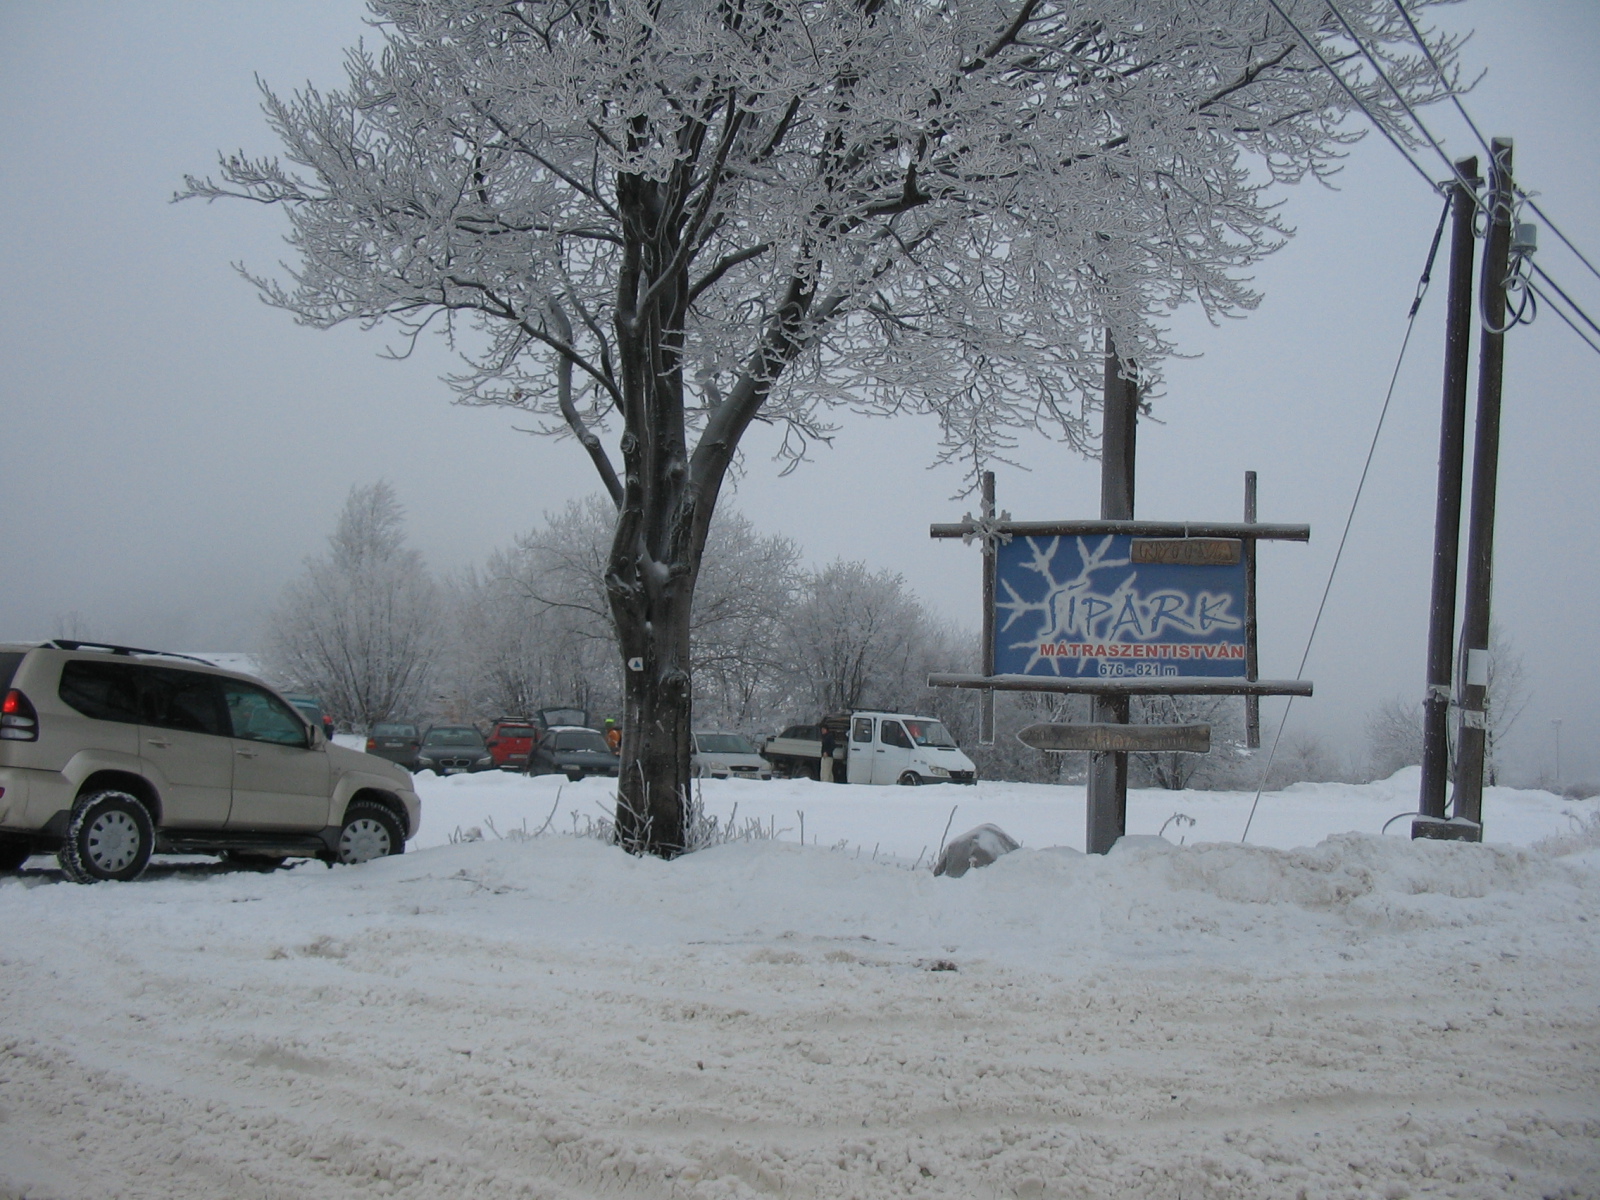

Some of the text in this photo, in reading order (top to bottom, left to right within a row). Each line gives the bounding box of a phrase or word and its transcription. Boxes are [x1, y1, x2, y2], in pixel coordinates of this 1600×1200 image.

[1042, 582, 1237, 641] SÍPARK
[1040, 641, 1244, 658] MÁTRASZENTISTVÁN
[1100, 664, 1124, 675] 676
[1137, 664, 1160, 675] 821
[1165, 667, 1176, 675] m
